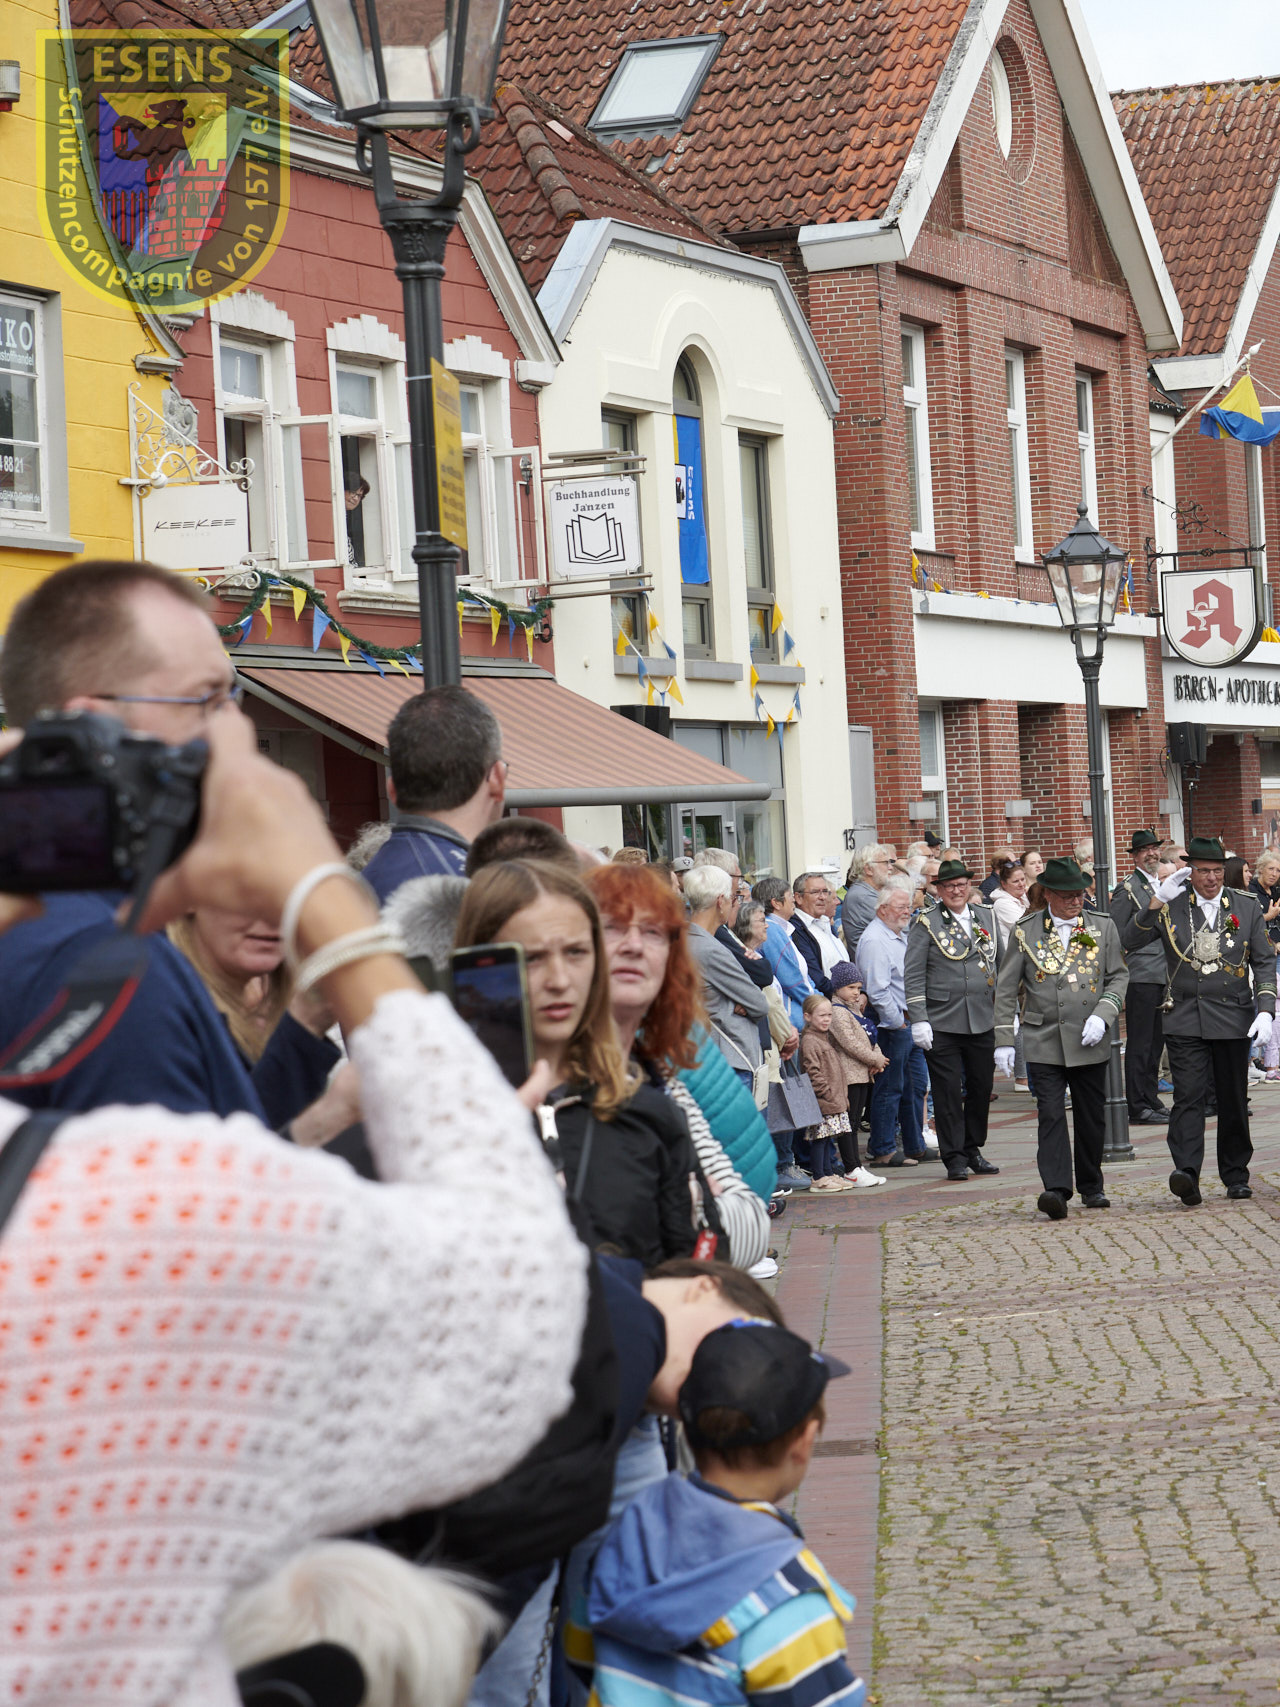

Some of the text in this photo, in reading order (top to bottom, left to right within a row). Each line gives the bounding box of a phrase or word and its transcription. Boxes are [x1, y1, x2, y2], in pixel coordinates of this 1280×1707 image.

[0, 317, 33, 351] KO
[555, 487, 630, 501] Buchhandlung
[572, 502, 615, 513] Janzen
